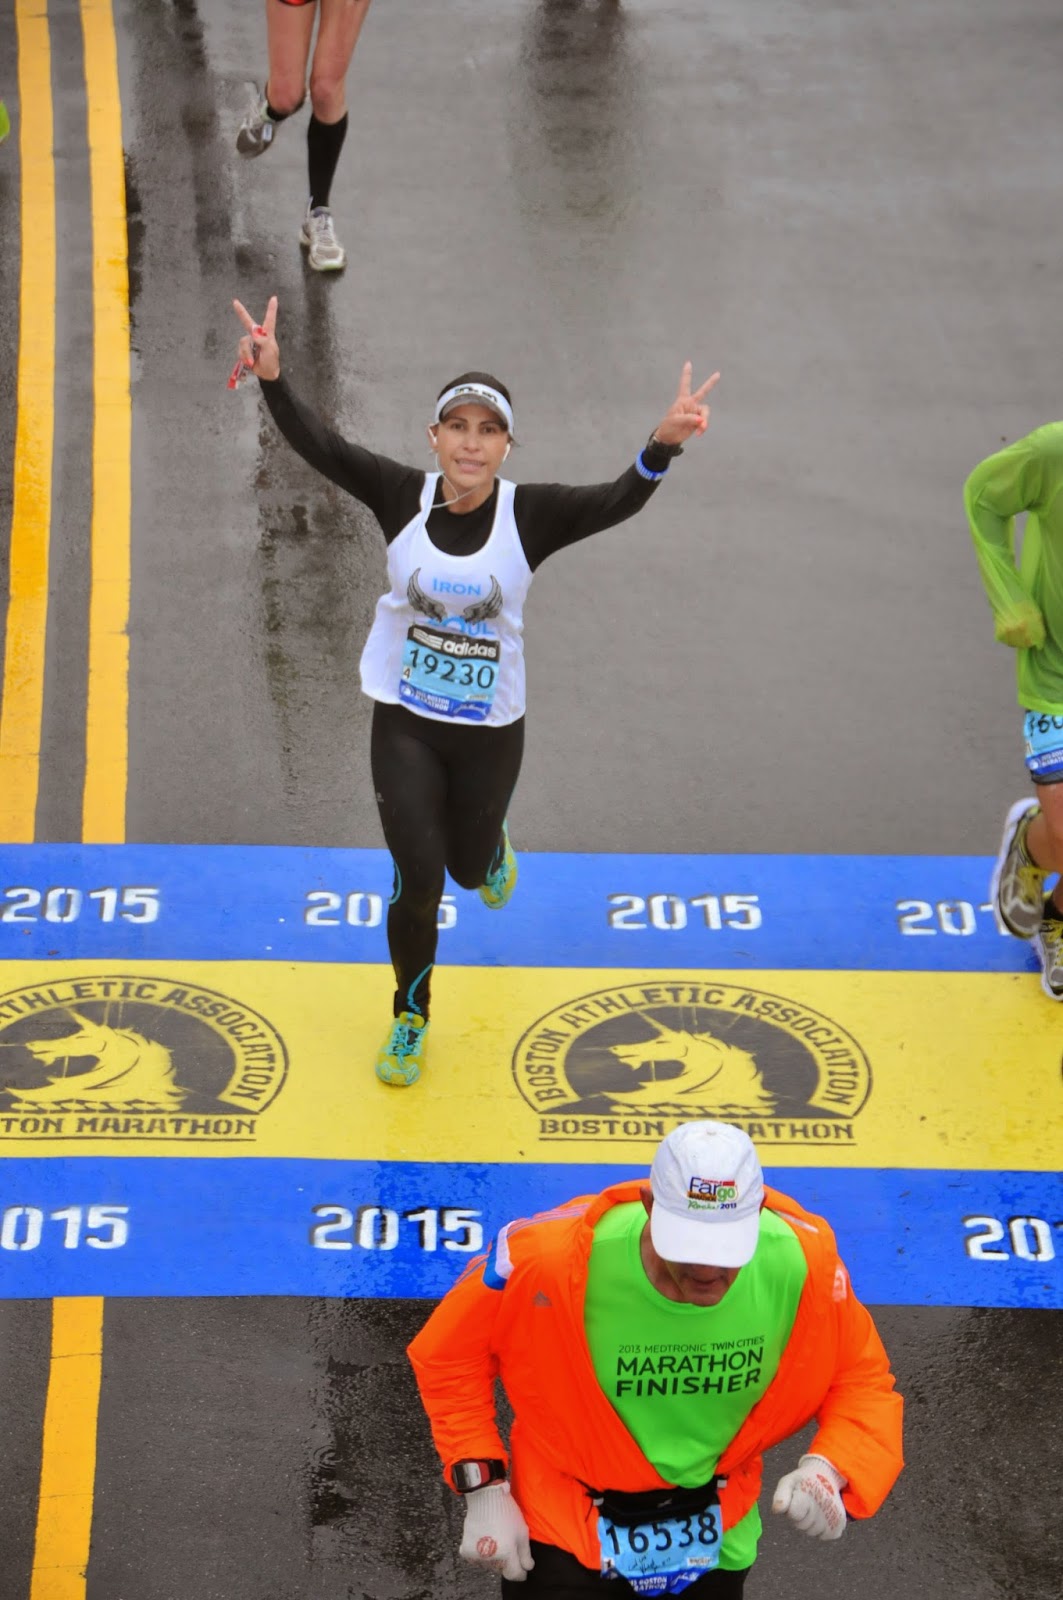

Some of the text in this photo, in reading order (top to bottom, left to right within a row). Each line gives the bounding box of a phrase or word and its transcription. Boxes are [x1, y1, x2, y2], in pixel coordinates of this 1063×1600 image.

[433, 577, 481, 595] IRON
[443, 639, 497, 659] adidas
[409, 648, 495, 689] 19230
[0, 886, 160, 924] 2015
[304, 890, 458, 930] 205
[608, 894, 763, 930] 2015
[160, 988, 276, 1101] ASSOCIATION
[525, 987, 859, 1105] BOSTON ATHLETIC ASSOCIATION
[76, 1117, 257, 1135] MARATHON
[540, 1118, 664, 1136] BOSTON
[690, 1176, 736, 1202] Fargo
[310, 1205, 483, 1252] 2015
[616, 1346, 763, 1376] MARATHON
[619, 1335, 765, 1354] 2013 MEDTRONIC TWIN CITIES
[616, 1367, 761, 1397] FINISHER
[606, 1513, 718, 1555] 16538
